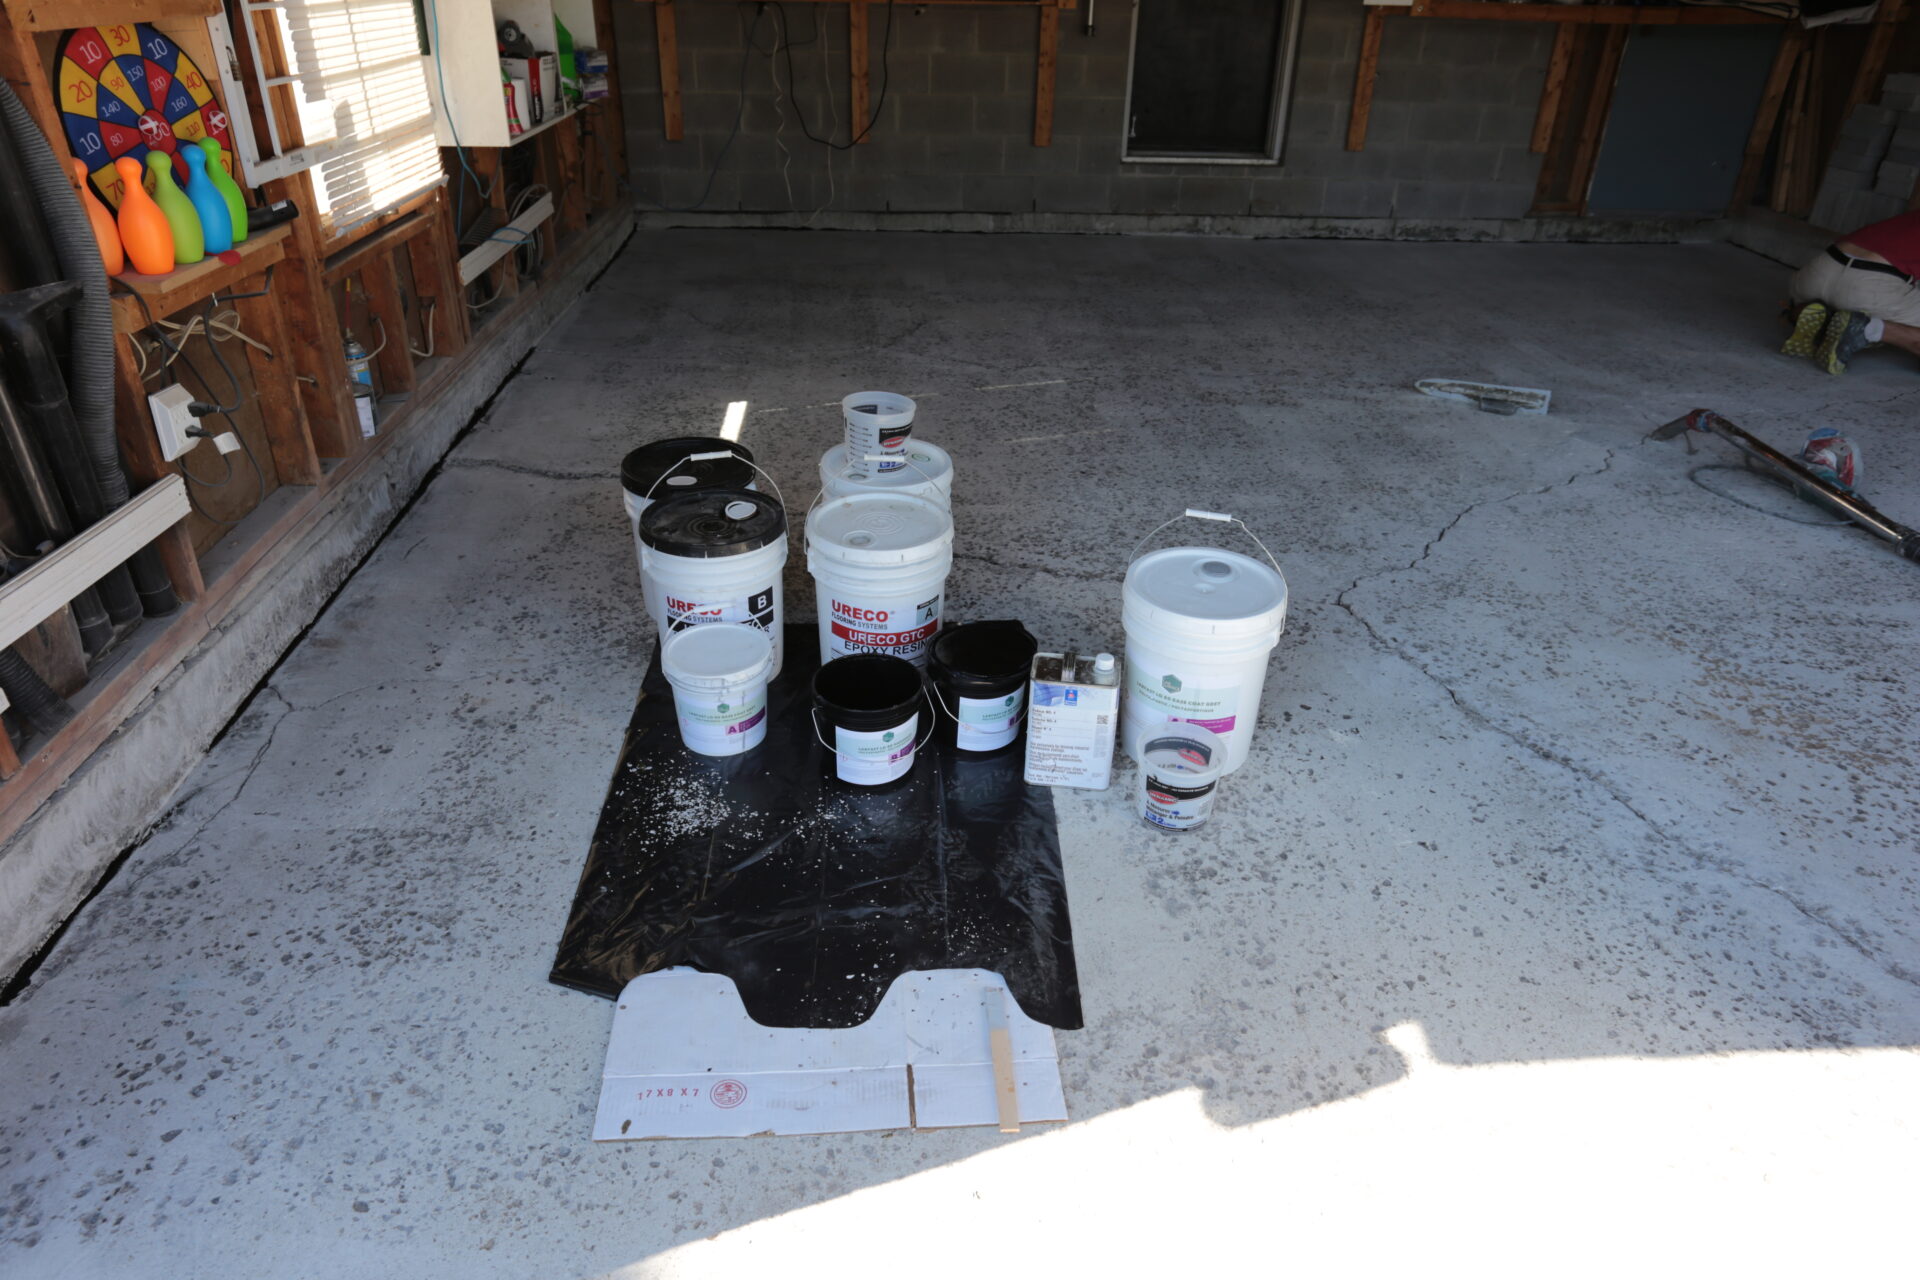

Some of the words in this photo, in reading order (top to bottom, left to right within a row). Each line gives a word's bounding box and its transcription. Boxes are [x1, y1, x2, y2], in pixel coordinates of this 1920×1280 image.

[109, 25, 131, 47] 30
[79, 41, 102, 65] 10
[147, 38, 168, 60] 10
[127, 65, 144, 82] 150
[186, 71, 203, 89] 40
[68, 80, 93, 103] 20
[110, 77, 125, 91] 90
[151, 76, 167, 91] 100
[102, 100, 121, 118] 140
[171, 96, 188, 113] 160
[186, 121, 201, 136] 110
[79, 132, 102, 156] 10
[110, 132, 124, 147] 80
[757, 595, 767, 610] B
[832, 599, 889, 623] URECO
[832, 611, 857, 626] FLOORING
[858, 621, 888, 630] SYSTEMS
[925, 606, 934, 621] A
[849, 629, 897, 645] URECO
[899, 628, 926, 643] GTC
[844, 640, 889, 655] EPOXY
[892, 640, 928, 655] RESIN
[728, 725, 737, 735] A
